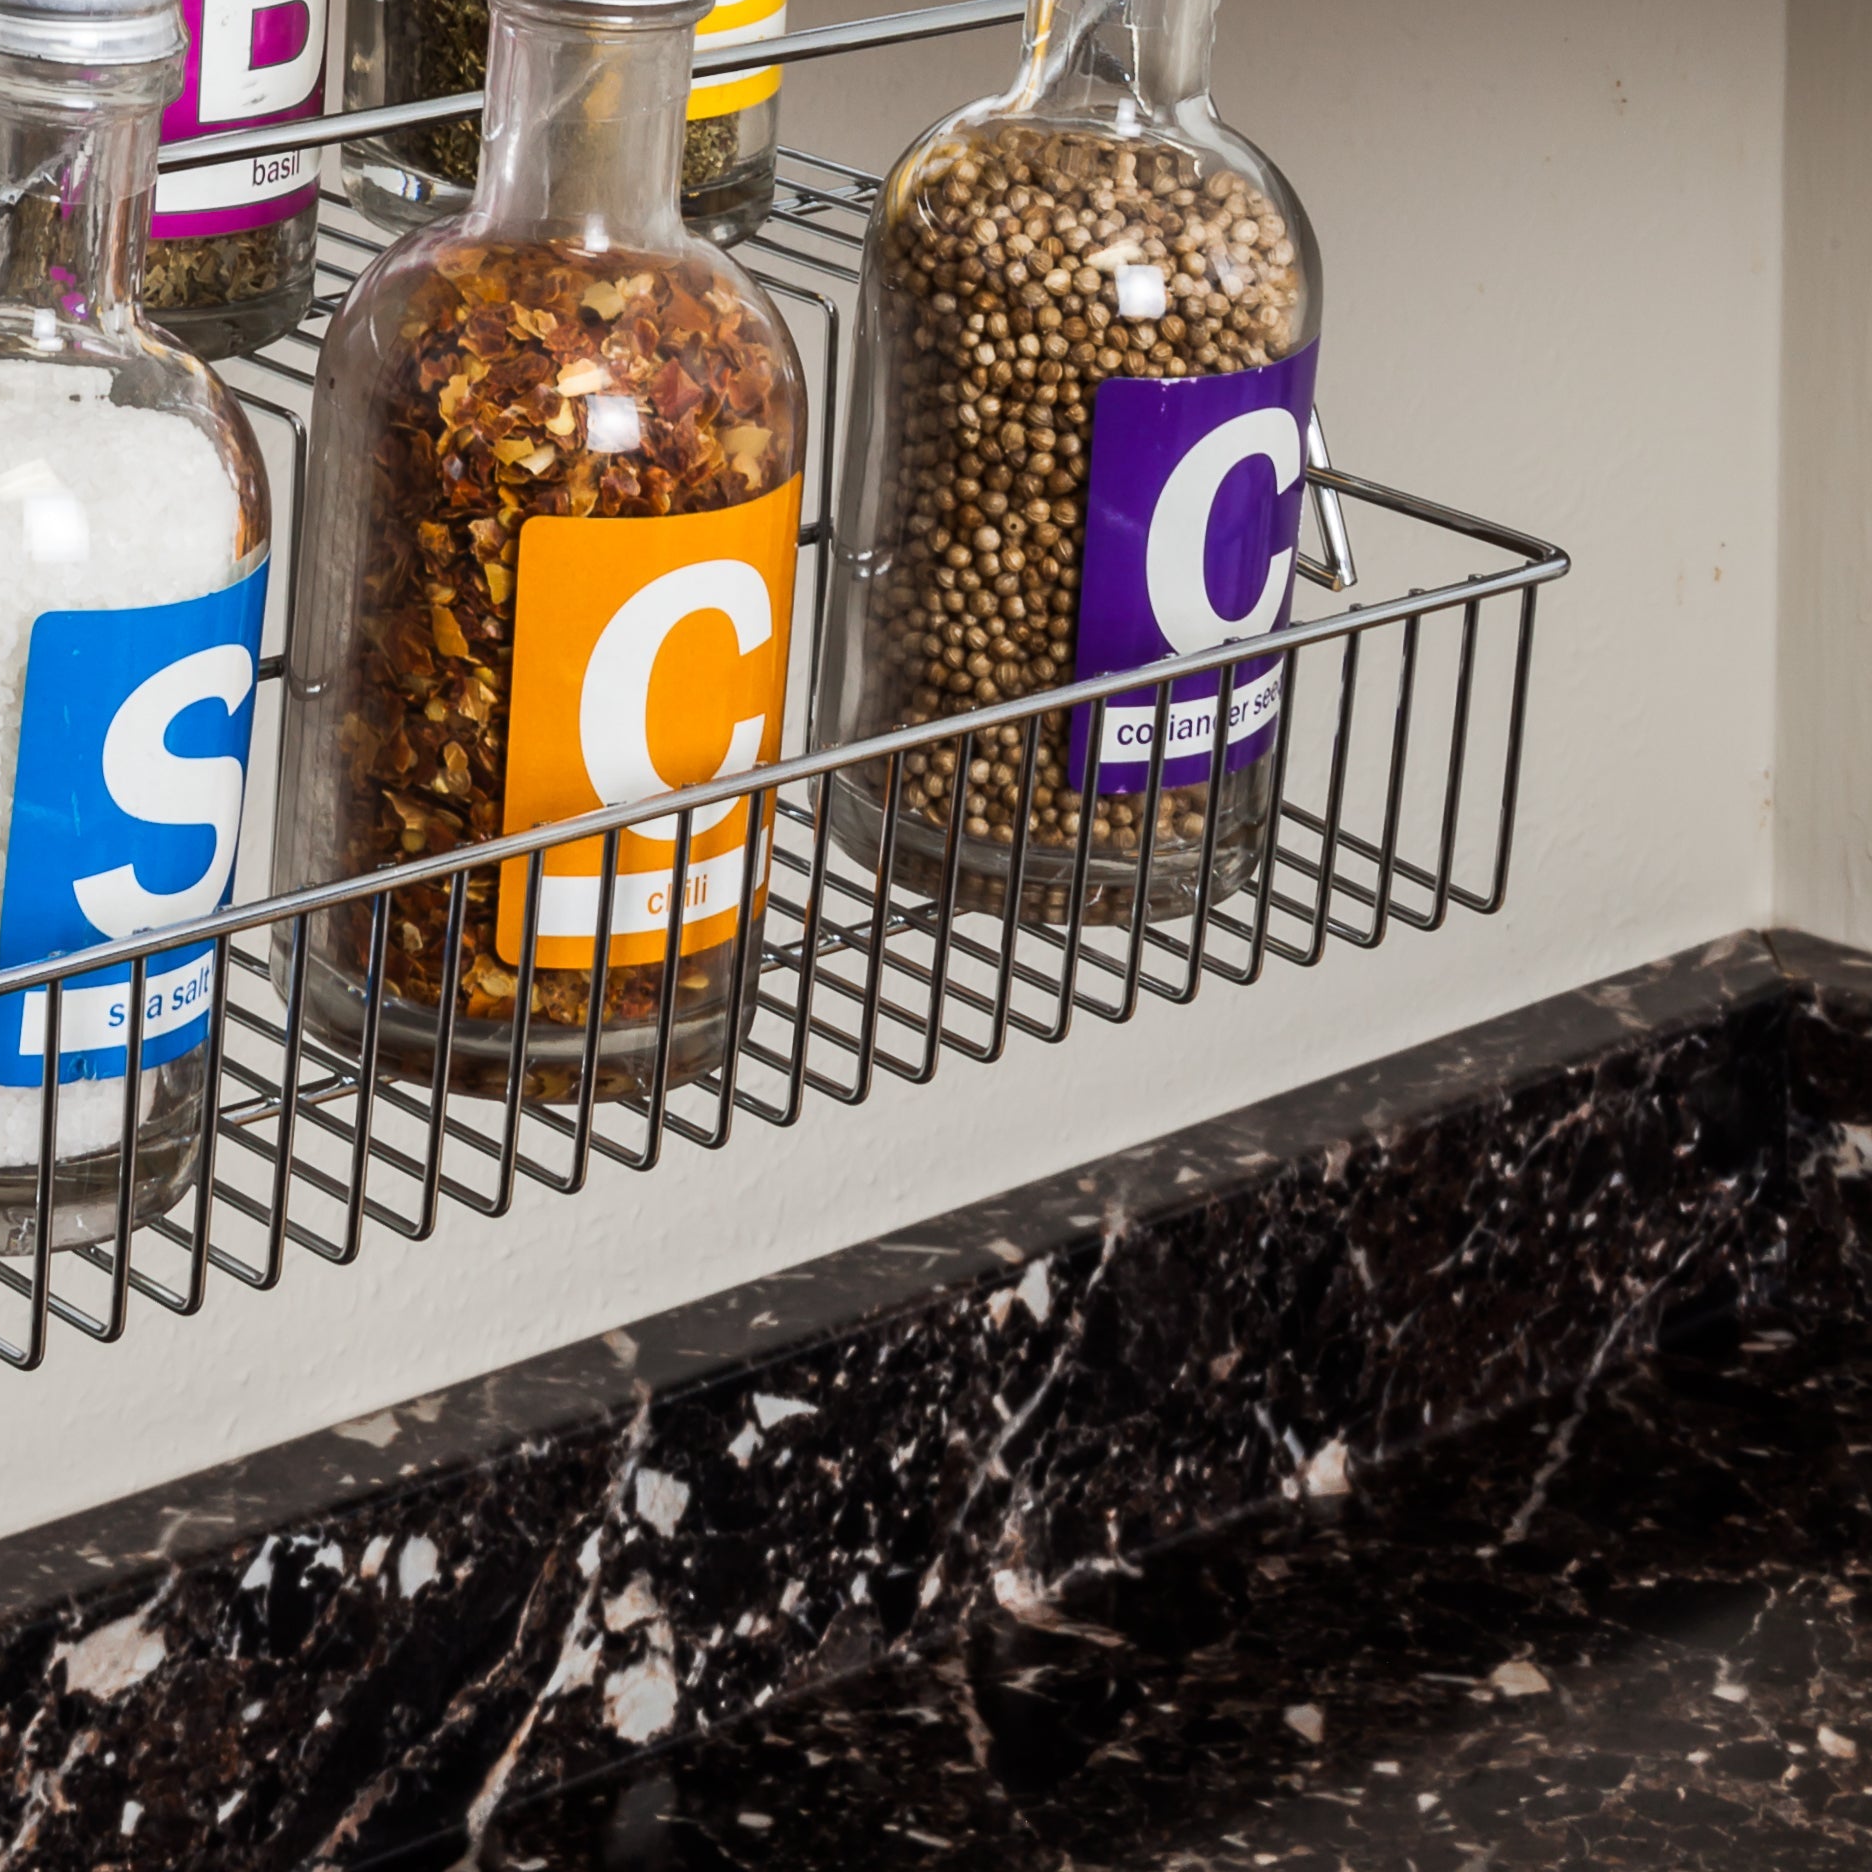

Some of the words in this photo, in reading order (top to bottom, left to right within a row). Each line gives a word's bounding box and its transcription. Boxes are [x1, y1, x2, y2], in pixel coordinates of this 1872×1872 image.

[250, 149, 302, 188] basil
[1145, 406, 1302, 660] C
[578, 558, 774, 842] C
[1116, 700, 1249, 746] coianer
[72, 642, 255, 942] S
[108, 991, 162, 1029] sa
[170, 963, 212, 1012] salt
